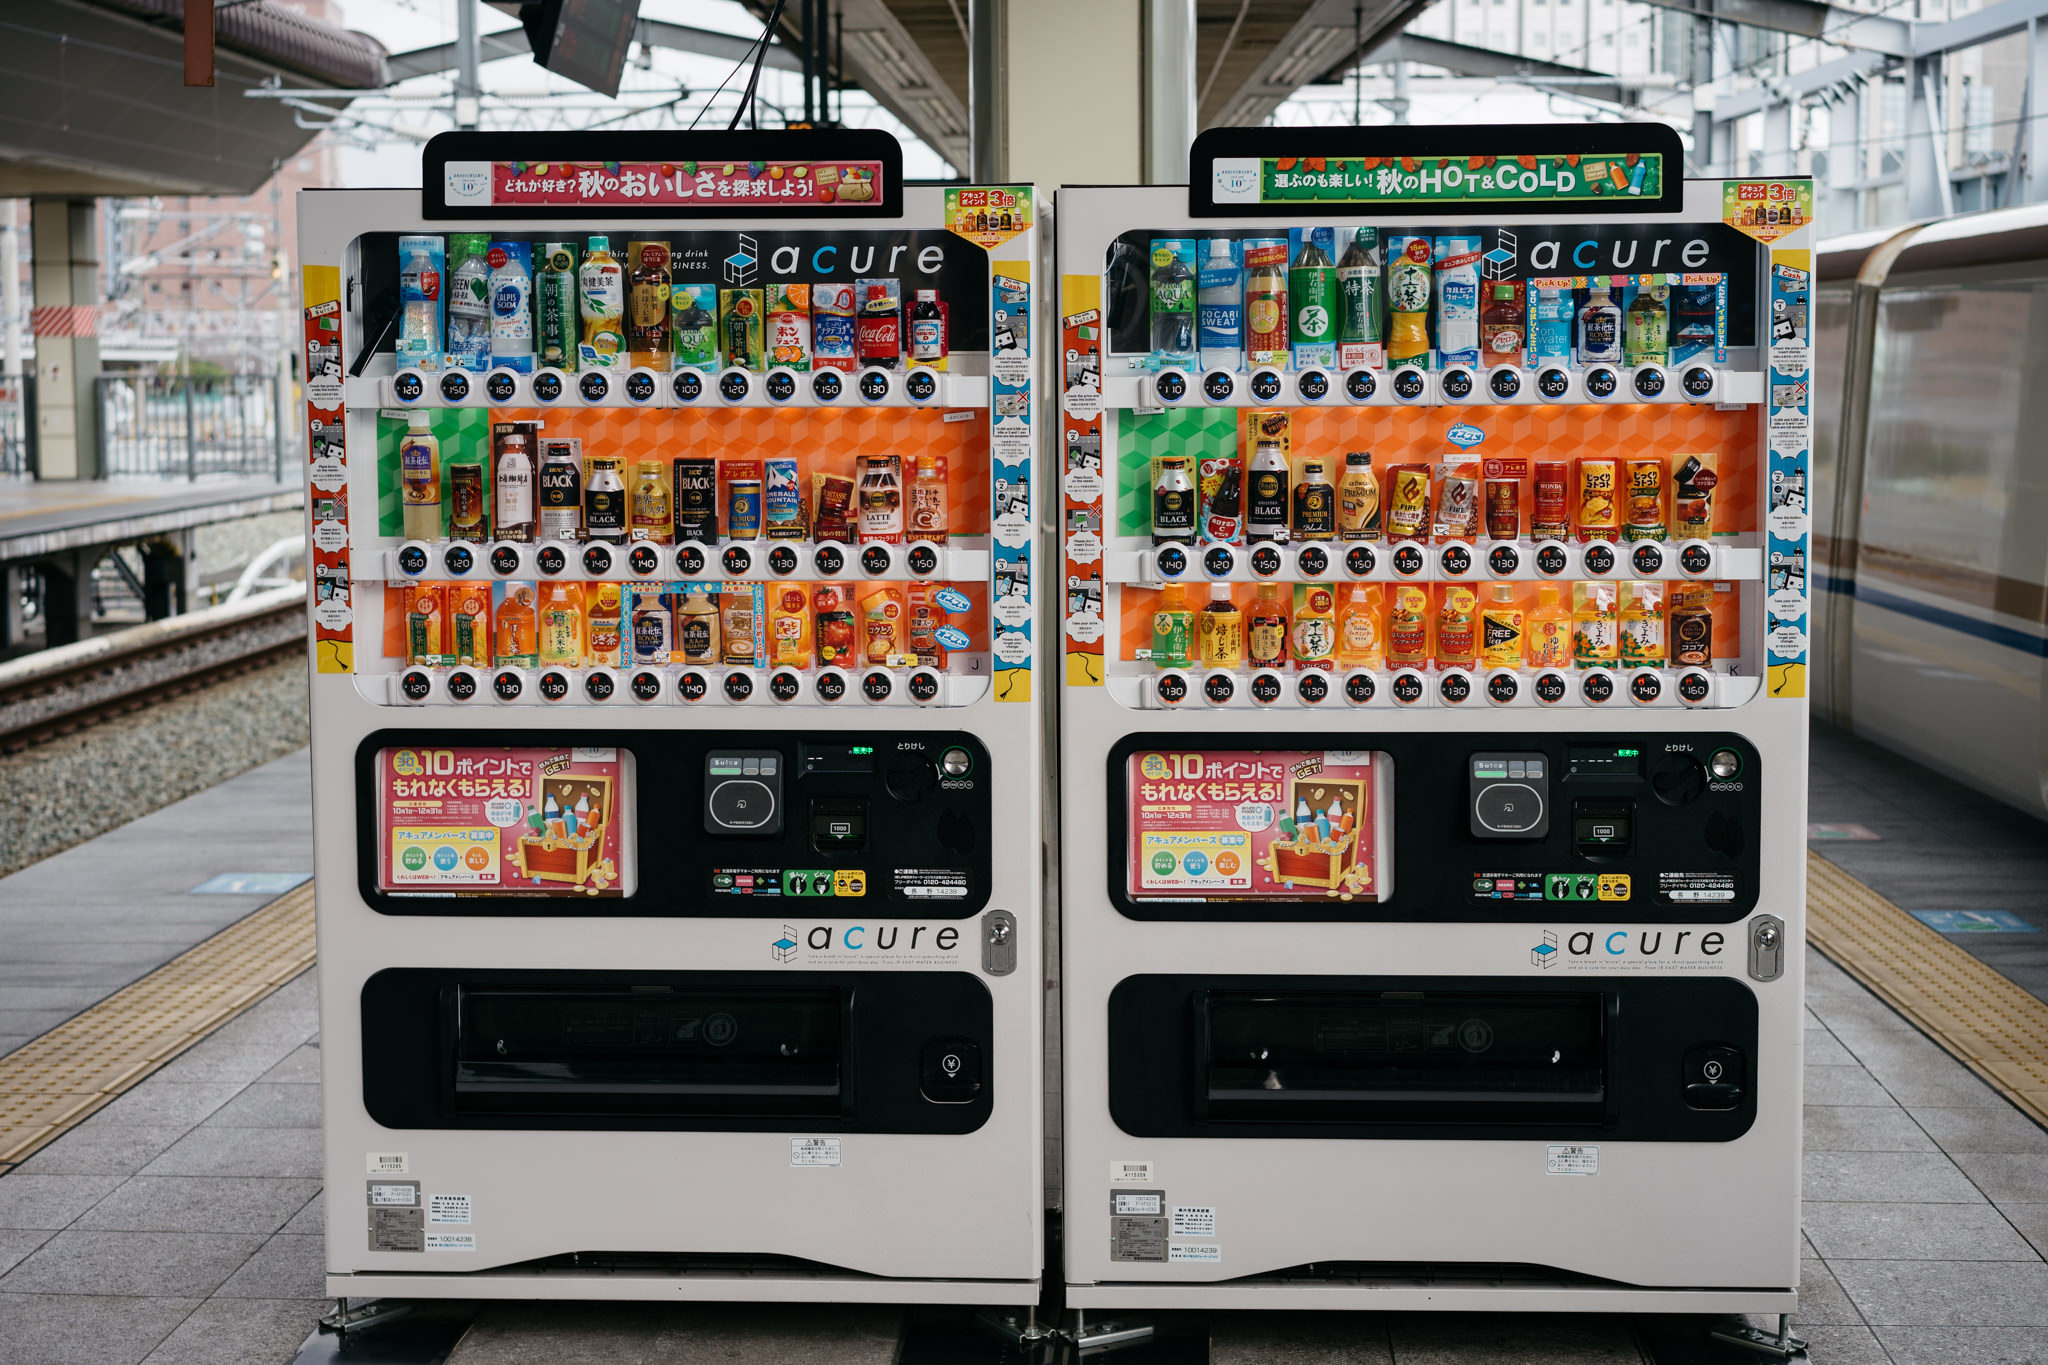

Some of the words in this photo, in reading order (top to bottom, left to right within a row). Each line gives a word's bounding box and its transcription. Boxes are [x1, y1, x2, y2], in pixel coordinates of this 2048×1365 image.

[1769, 184, 1795, 201] 3倍
[989, 190, 1015, 207] 3倍
[1530, 239, 1710, 270] acure
[771, 245, 944, 274] acure
[1782, 270, 1801, 280] Cash
[1003, 281, 1021, 292] Cash
[1345, 279, 1374, 296] 特茶
[1402, 266, 1421, 310] 十六茶
[496, 293, 517, 302] CALPIS
[497, 301, 517, 309] SODA
[545, 283, 559, 337] 朝の茶事
[1201, 310, 1239, 318] POCARI
[1201, 318, 1236, 326] SWEAT
[1301, 308, 1326, 334] 茶
[859, 324, 897, 343] Coca-Cola
[1540, 327, 1555, 336] on
[776, 337, 800, 345] ジュース
[1538, 334, 1567, 344] water
[496, 385, 512, 394] 160
[542, 385, 558, 394] 140
[635, 385, 651, 394] 150
[682, 385, 698, 394] 100
[729, 385, 745, 394] 120
[822, 385, 838, 394] 150
[869, 385, 885, 394] 130
[916, 384, 932, 393] 160
[1166, 385, 1182, 394] 110
[1213, 385, 1229, 394] 150
[1308, 384, 1324, 393] 160
[1356, 384, 1372, 393] 190
[1404, 384, 1420, 393] 150
[1500, 382, 1516, 391] 130
[1548, 382, 1564, 391] 120
[1596, 382, 1612, 391] 140
[1693, 381, 1709, 390] 100
[403, 386, 419, 395] 120
[495, 425, 514, 433] NEW
[1449, 430, 1482, 441] オススメ
[1586, 473, 1611, 482] じっくり
[1634, 471, 1658, 480] じっくり
[542, 475, 573, 488] BLACK
[682, 477, 710, 490] BLACK
[1586, 481, 1610, 489] コトコト
[1634, 479, 1658, 487] コトコト
[1344, 488, 1376, 497] PREMIUM
[1254, 506, 1281, 515] BLACK
[589, 515, 616, 523] BLACK
[454, 559, 470, 568] 120
[500, 559, 516, 568] 160
[546, 559, 562, 568] 160
[638, 559, 654, 568] 140
[685, 559, 701, 568] 130
[777, 559, 793, 568] 130
[824, 559, 840, 568] 130
[871, 559, 887, 568] 150
[1166, 561, 1182, 570] 140
[1213, 560, 1229, 569] 120
[1308, 559, 1324, 568] 140
[1355, 560, 1371, 569] 150
[1403, 560, 1419, 569] 130
[1498, 559, 1514, 568] 130
[1546, 559, 1562, 568] 130
[1642, 558, 1658, 567] 130
[1690, 558, 1706, 567] 170
[868, 626, 893, 635] コクとろ
[1487, 629, 1511, 638] FREE
[1595, 620, 1605, 646] きよみ
[1640, 619, 1650, 646] きよみ
[1307, 620, 1324, 656] 十六茶
[1487, 637, 1502, 645] Tea
[971, 659, 979, 670] J
[1729, 665, 1738, 676] K
[411, 684, 427, 693] 120
[457, 684, 473, 693] 120
[503, 684, 519, 693] 130
[595, 684, 611, 693] 130
[641, 684, 657, 693] 140
[687, 685, 703, 694] 140
[779, 685, 795, 694] 140
[826, 685, 842, 694] 160
[872, 685, 888, 694] 130
[1167, 687, 1183, 696] 130
[1261, 687, 1277, 696] 130
[1308, 687, 1324, 696] 130
[1355, 687, 1371, 696] 130
[1450, 687, 1466, 696] 130
[1497, 687, 1513, 696] 140
[1545, 687, 1561, 696] 130
[1640, 687, 1656, 696] 140
[1688, 686, 1704, 695] 160
[897, 742, 925, 750] とりけし
[1664, 743, 1694, 752] とりけし
[1618, 749, 1639, 757] 販売中
[421, 751, 532, 776] 10ポイントで
[1170, 754, 1283, 779] 10ポイントで
[545, 761, 570, 776] GET!
[1297, 764, 1322, 779] GET!
[392, 779, 531, 797] もれなくもらえる!
[1140, 783, 1281, 801] もれなくもらえる!
[397, 830, 467, 841] アキュアメンバーズ
[1146, 835, 1217, 845] アキュアメンバーズ
[807, 926, 960, 950] acure
[1567, 931, 1725, 955] acure
[439, 1235, 473, 1243] 10014238
